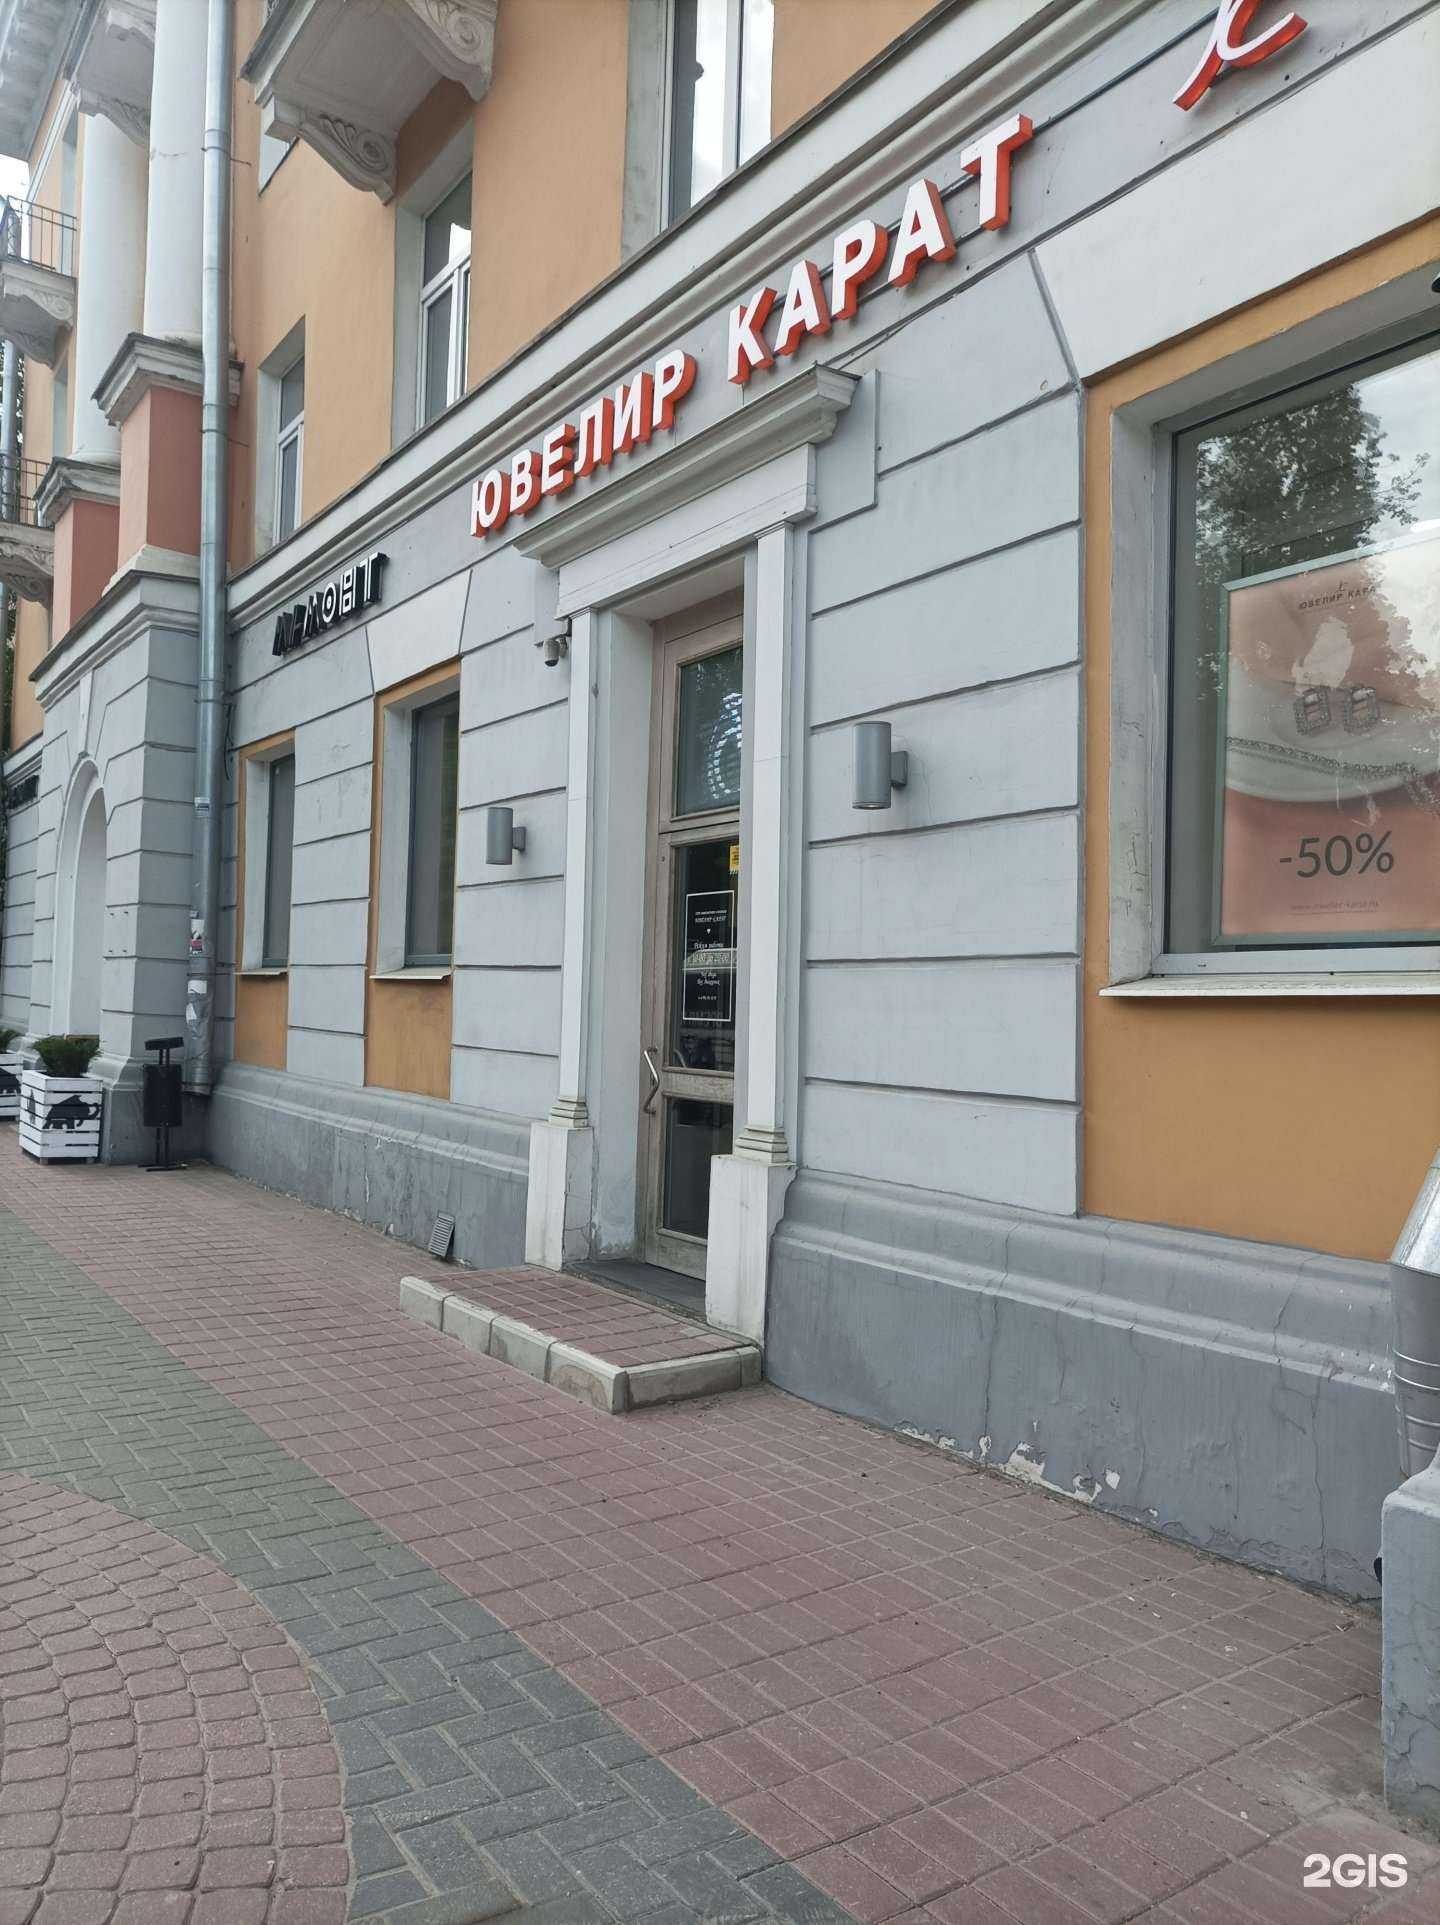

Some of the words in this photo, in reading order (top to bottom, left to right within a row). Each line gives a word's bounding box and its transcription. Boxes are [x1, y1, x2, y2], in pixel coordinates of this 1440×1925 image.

[470, 349, 696, 538] ЮВЕЛИР
[728, 113, 1034, 384] КАРАТ
[1347, 584, 1380, 599] КАРА
[1279, 830, 1394, 879] -50%
